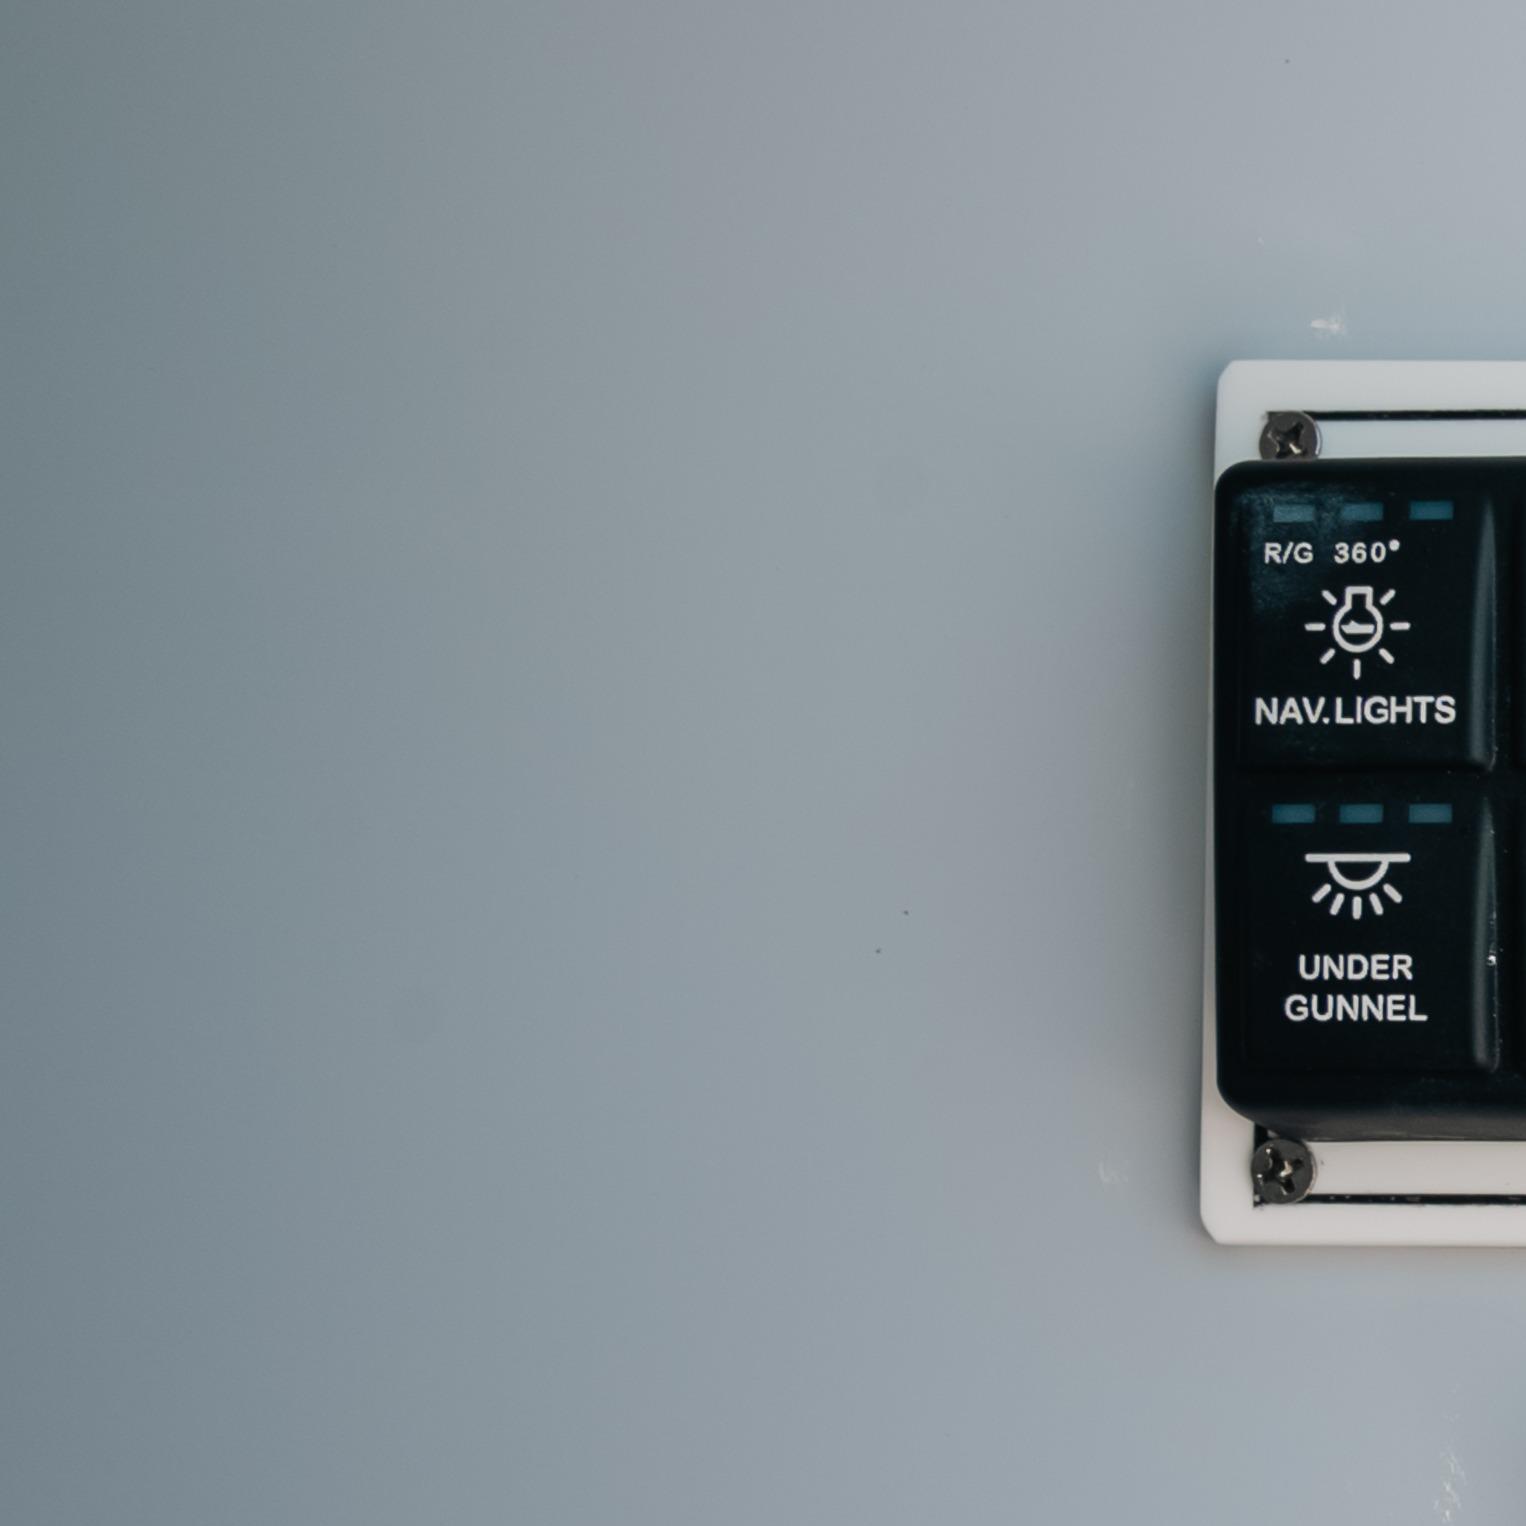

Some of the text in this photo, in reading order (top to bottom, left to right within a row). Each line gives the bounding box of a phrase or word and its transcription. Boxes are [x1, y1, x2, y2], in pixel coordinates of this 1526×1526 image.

[1264, 541, 1314, 564] R/G
[1299, 953, 1413, 980] UNDER
[1284, 994, 1428, 1022] GUNNEL
